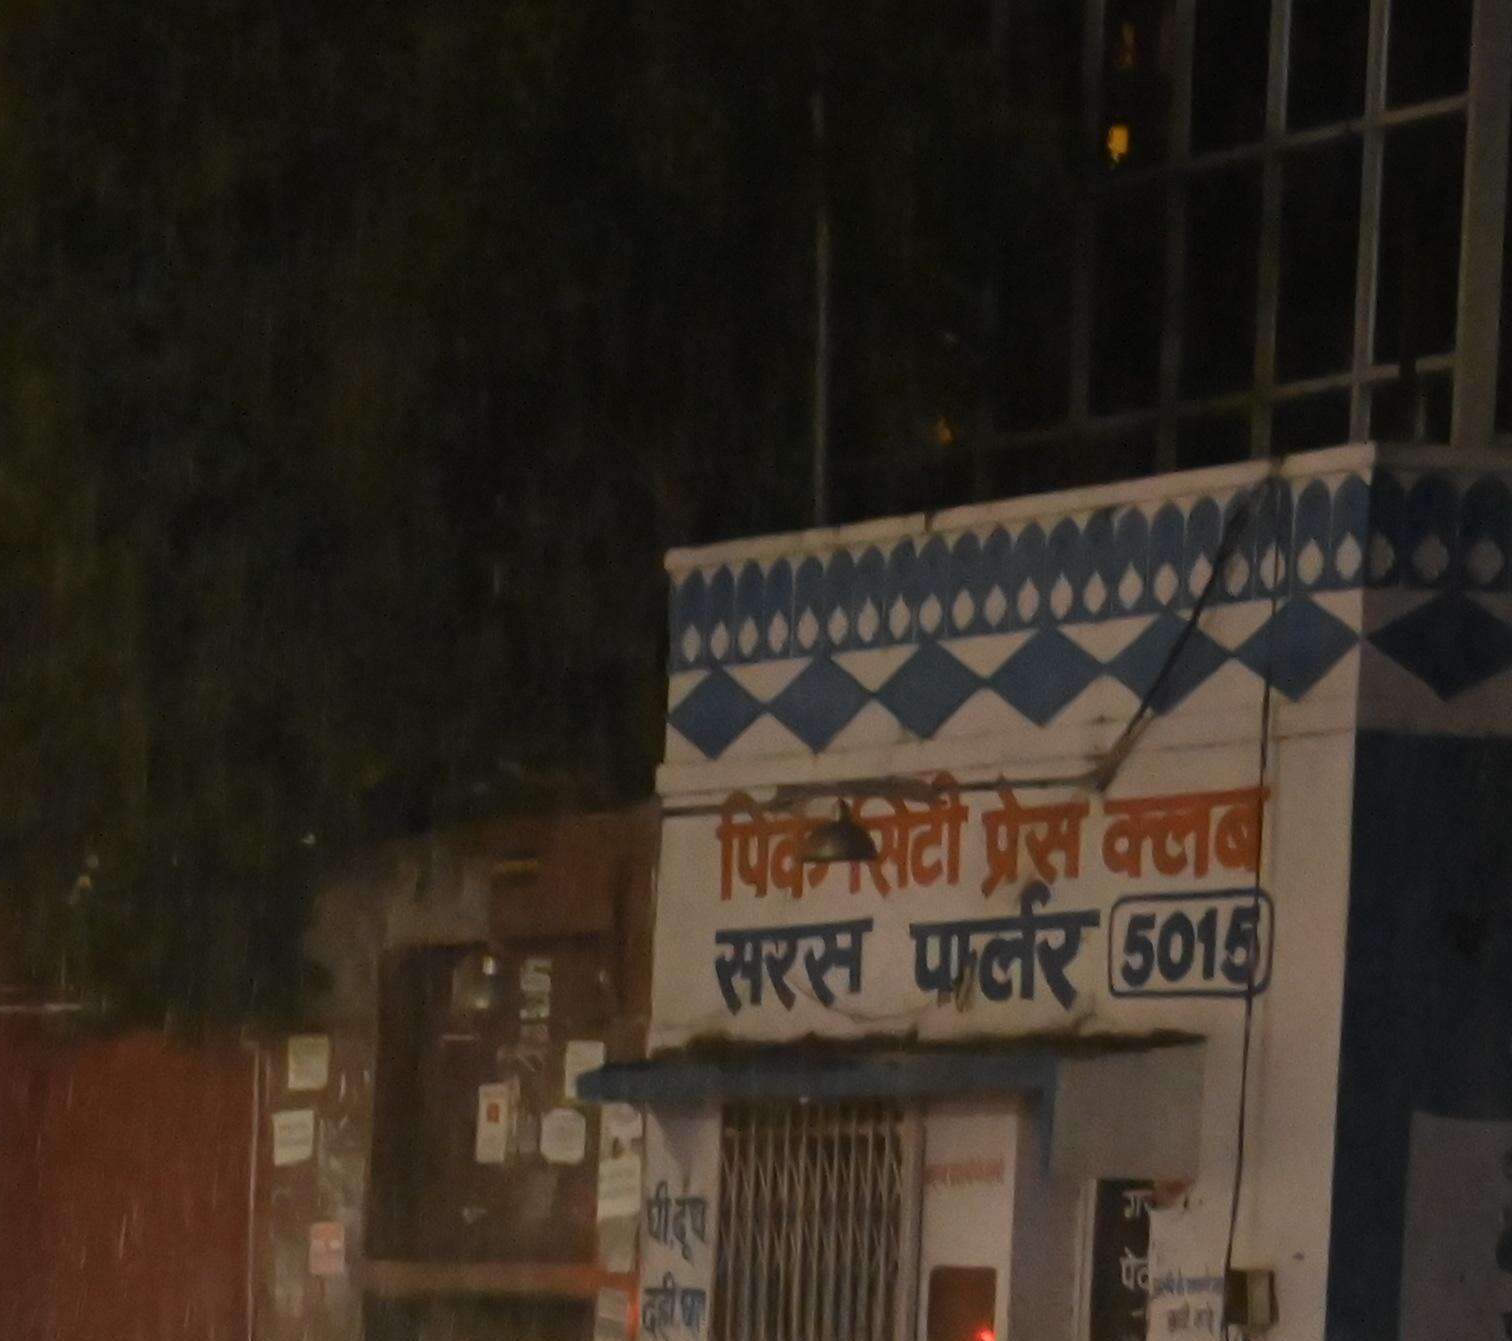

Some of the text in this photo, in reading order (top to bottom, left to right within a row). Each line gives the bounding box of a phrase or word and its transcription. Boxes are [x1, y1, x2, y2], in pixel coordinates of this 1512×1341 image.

[981, 774, 1090, 898] प्रेस
[1100, 786, 1271, 879] क्लब
[714, 880, 1262, 1015] सरस पार्लर 5015
